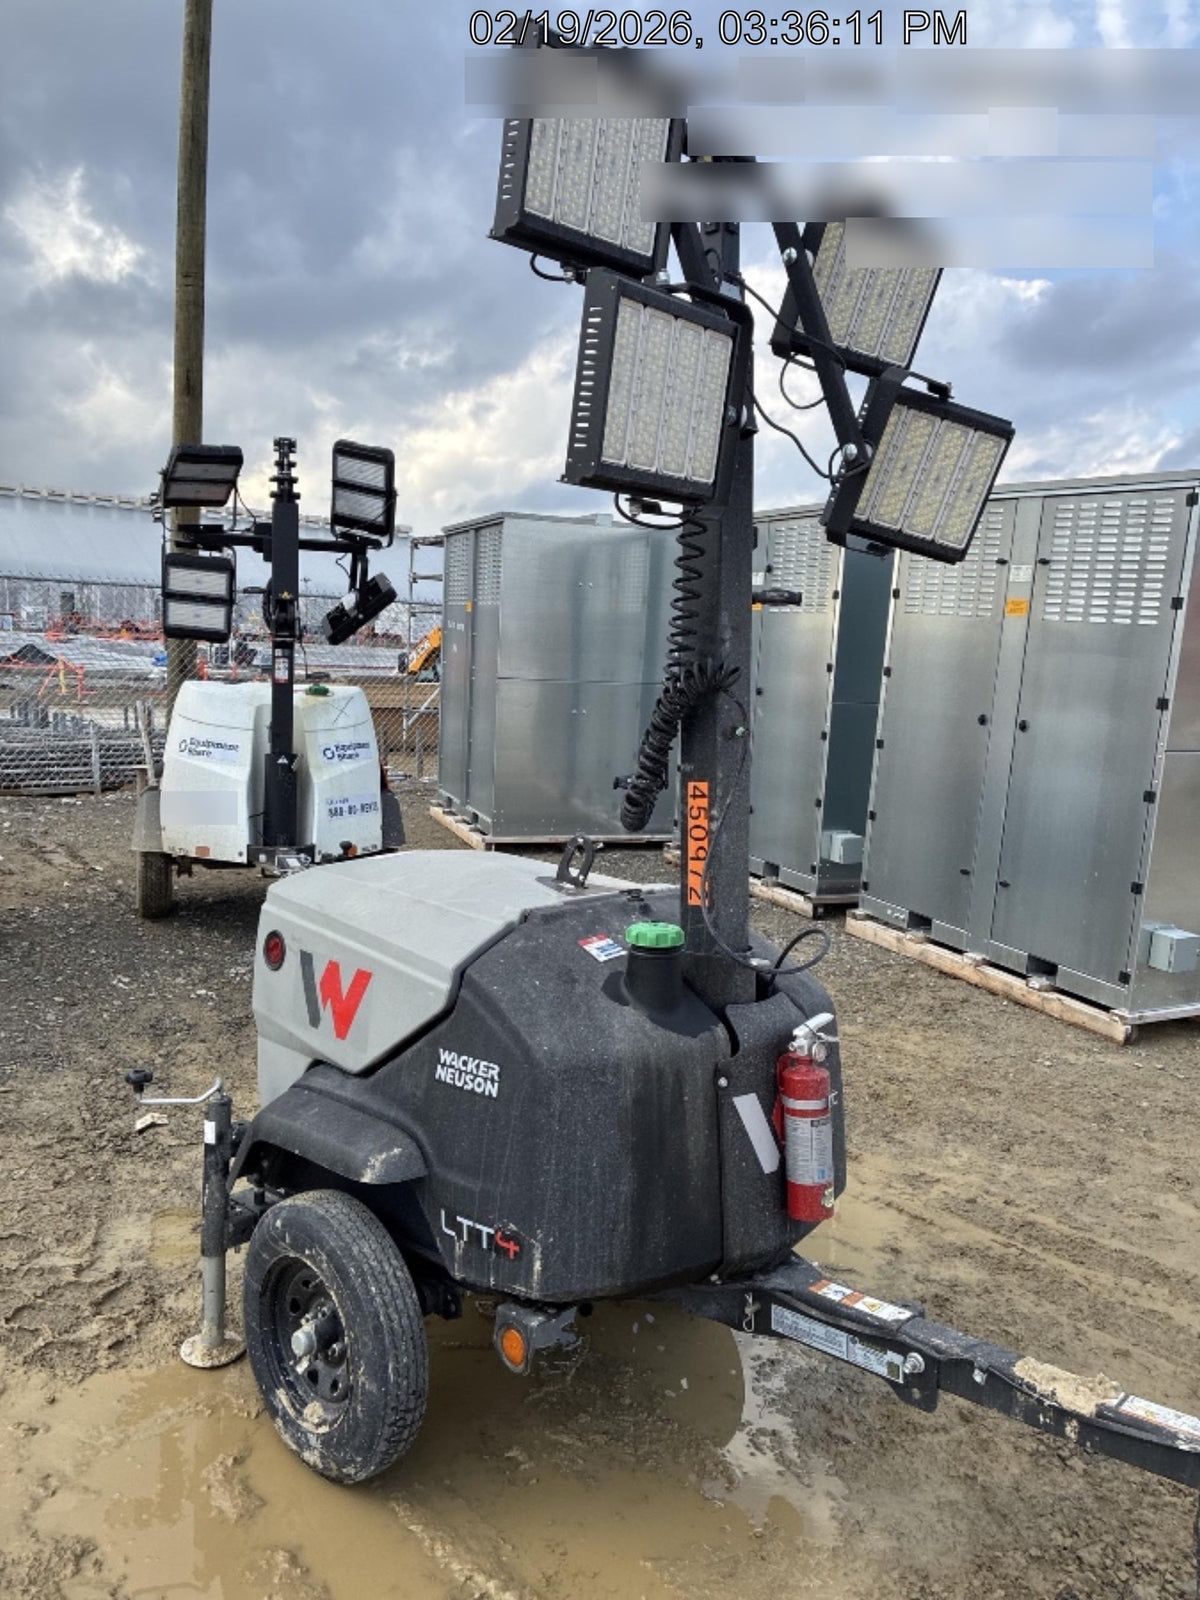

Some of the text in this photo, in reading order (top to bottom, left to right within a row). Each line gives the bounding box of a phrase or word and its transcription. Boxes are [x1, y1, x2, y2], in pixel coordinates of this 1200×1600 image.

[435, 1064, 498, 1098] NEUSON
[438, 1048, 500, 1081] WACKER
[440, 1208, 520, 1261] LTT4
